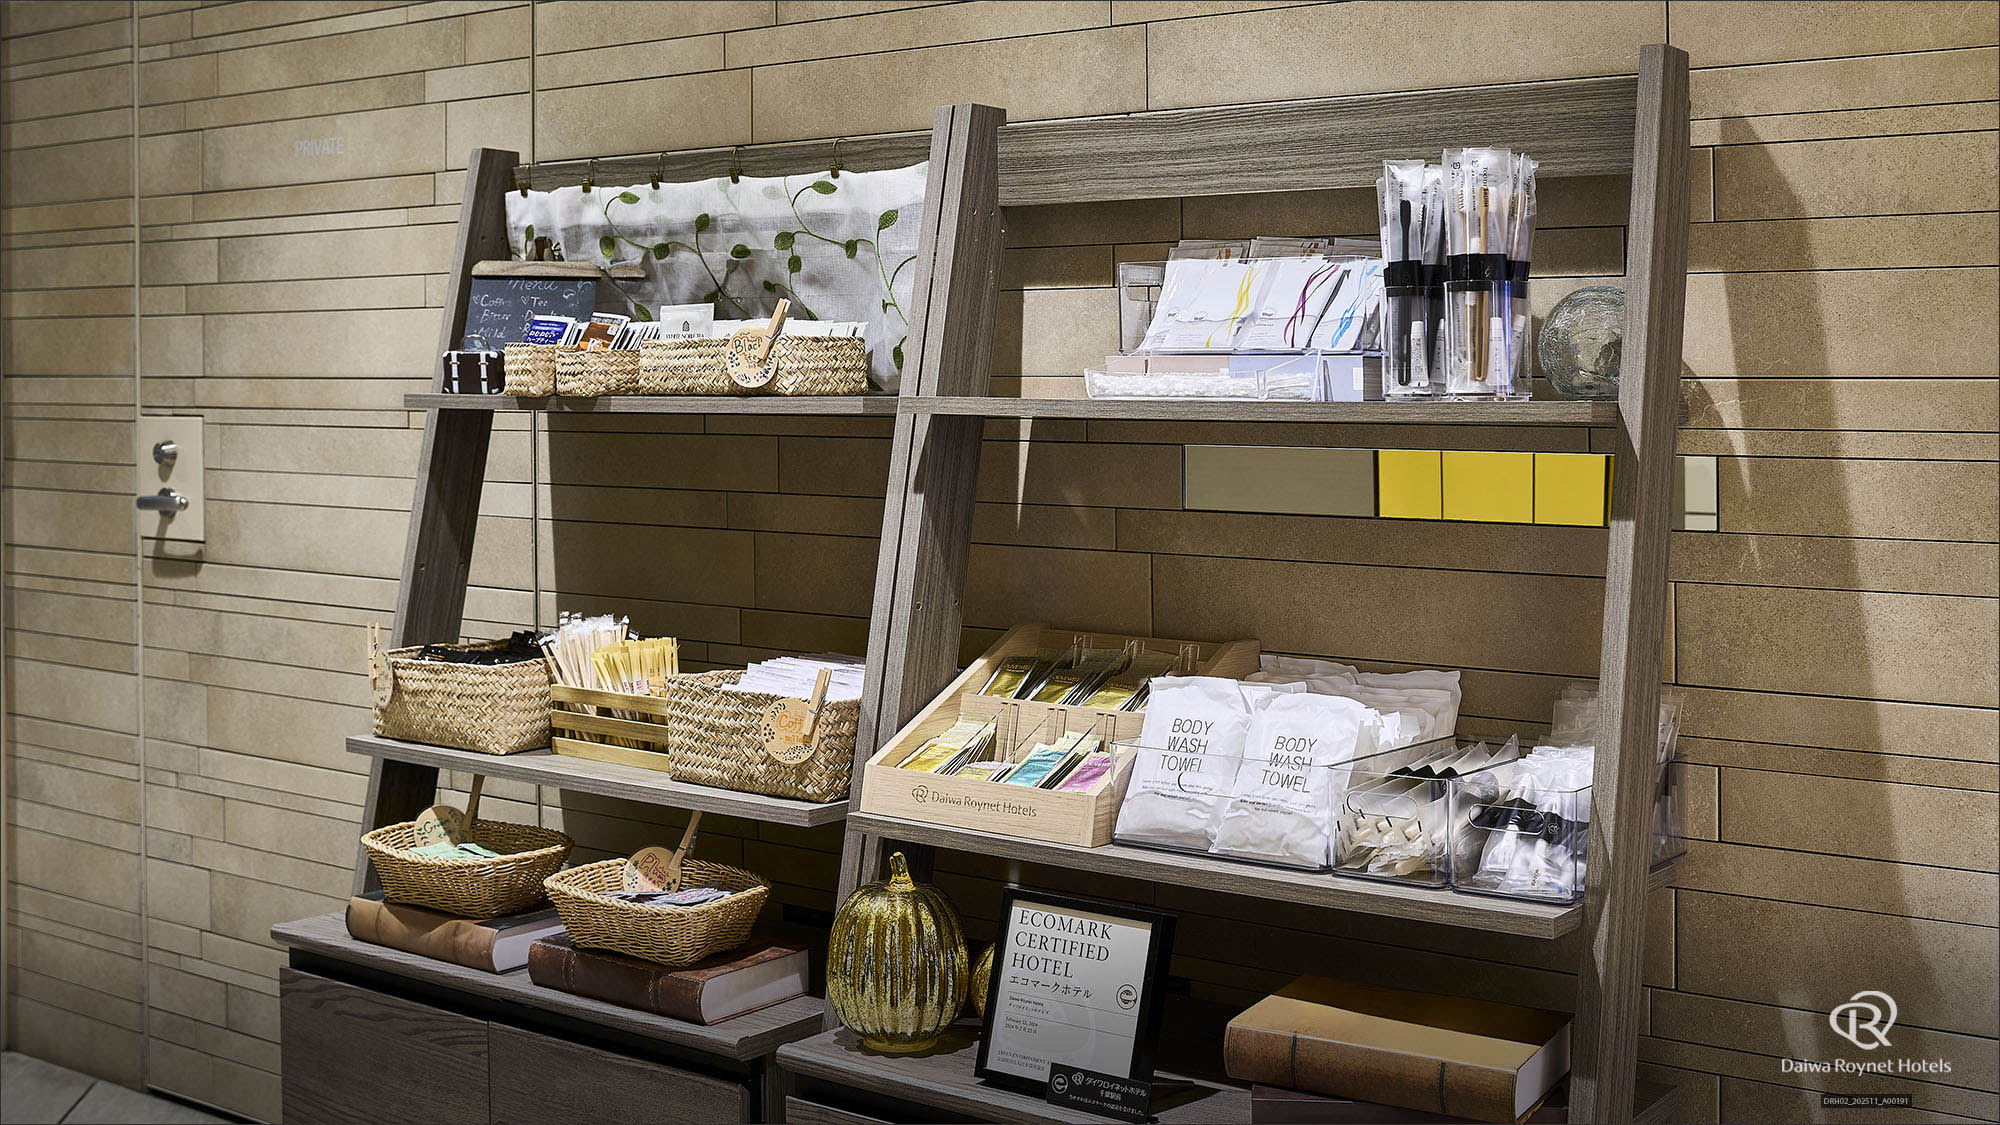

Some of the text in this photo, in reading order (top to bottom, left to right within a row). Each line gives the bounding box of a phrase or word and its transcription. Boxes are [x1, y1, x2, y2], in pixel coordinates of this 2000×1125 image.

[295, 136, 344, 157] PRIVATE
[1172, 717, 1214, 735] BODY
[1167, 736, 1209, 755] WASH
[1274, 735, 1317, 753] BODY
[1269, 752, 1313, 773] WASH
[1261, 768, 1310, 793] TOWEL
[931, 791, 1037, 818] Daiwa Roynet Hotels
[1019, 909, 1113, 940] ECOMARK
[1015, 931, 1109, 962] CERTIFIED
[1012, 952, 1074, 978] HOTEL
[1009, 975, 1093, 999] エコマークホテル
